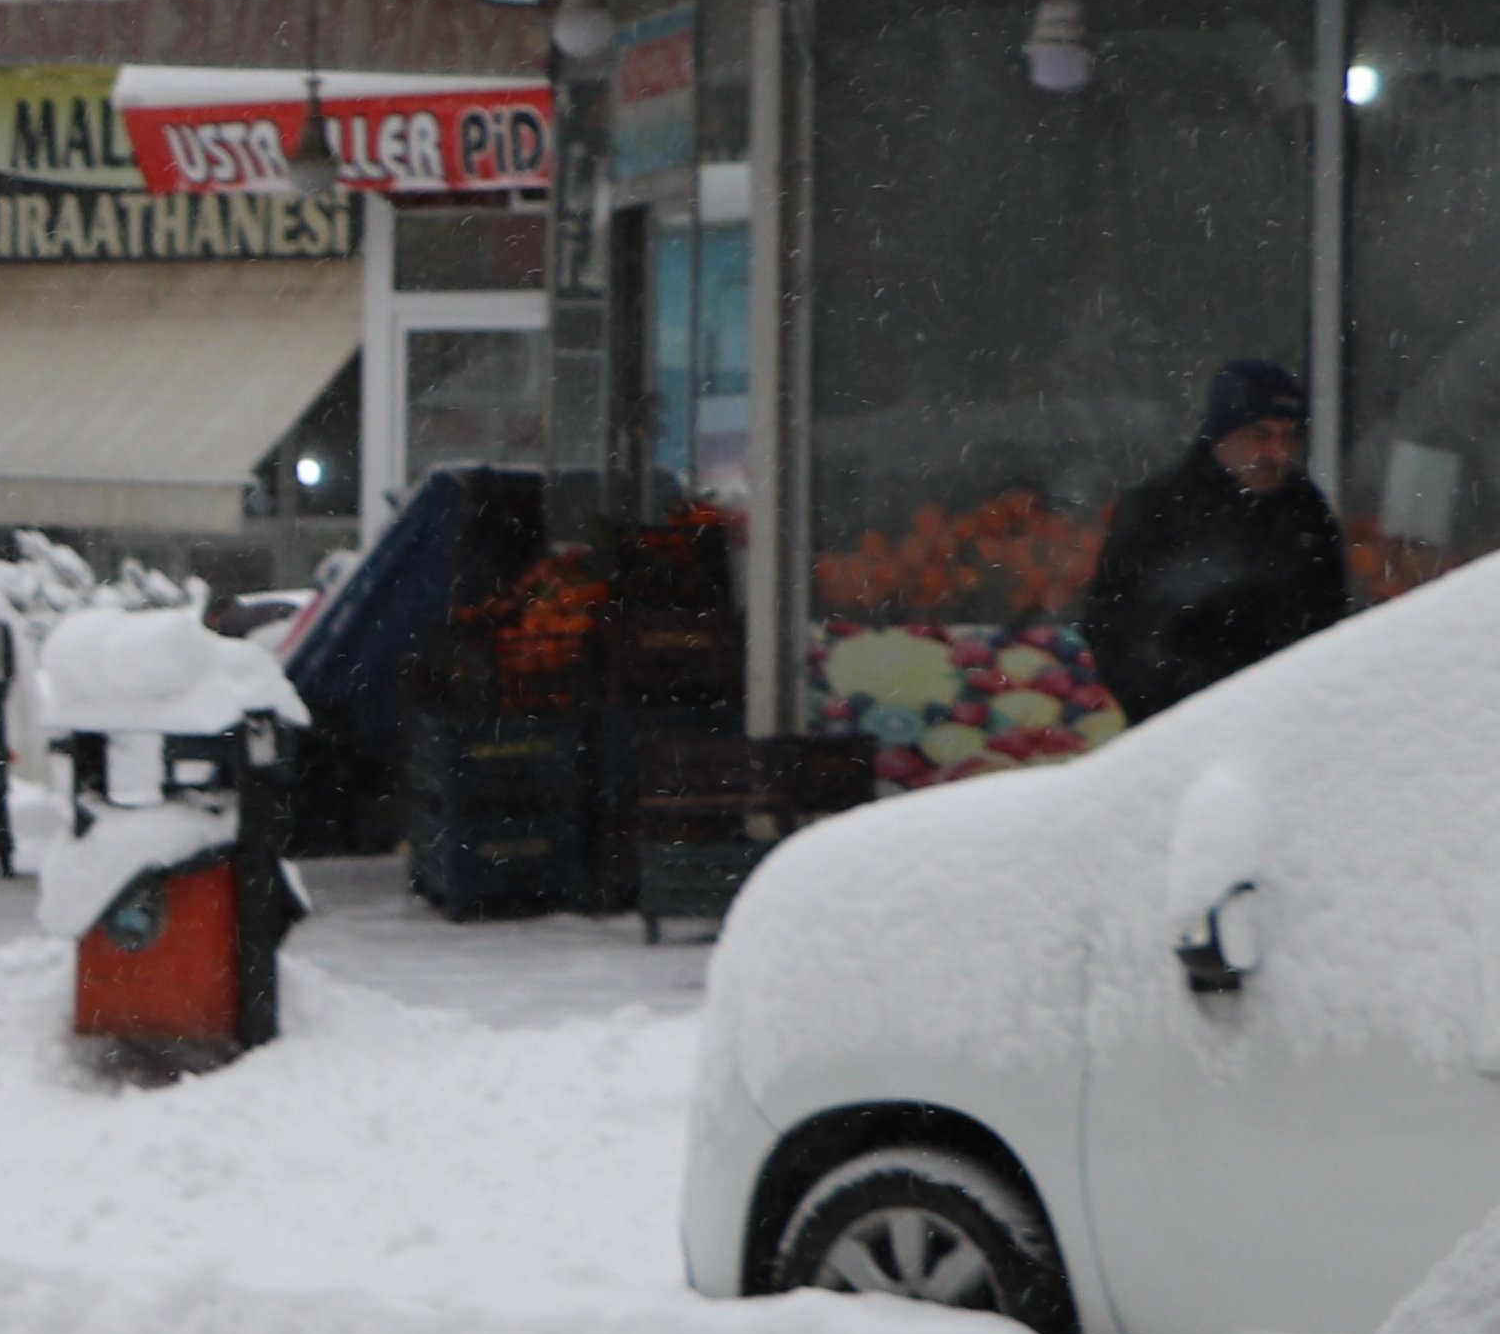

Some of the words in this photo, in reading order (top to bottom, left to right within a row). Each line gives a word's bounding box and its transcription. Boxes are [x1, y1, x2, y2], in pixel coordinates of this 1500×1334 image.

[14, 95, 133, 170] MAL
[162, 116, 293, 185] USTA
[323, 110, 445, 183] LLER
[459, 101, 549, 177] PİD
